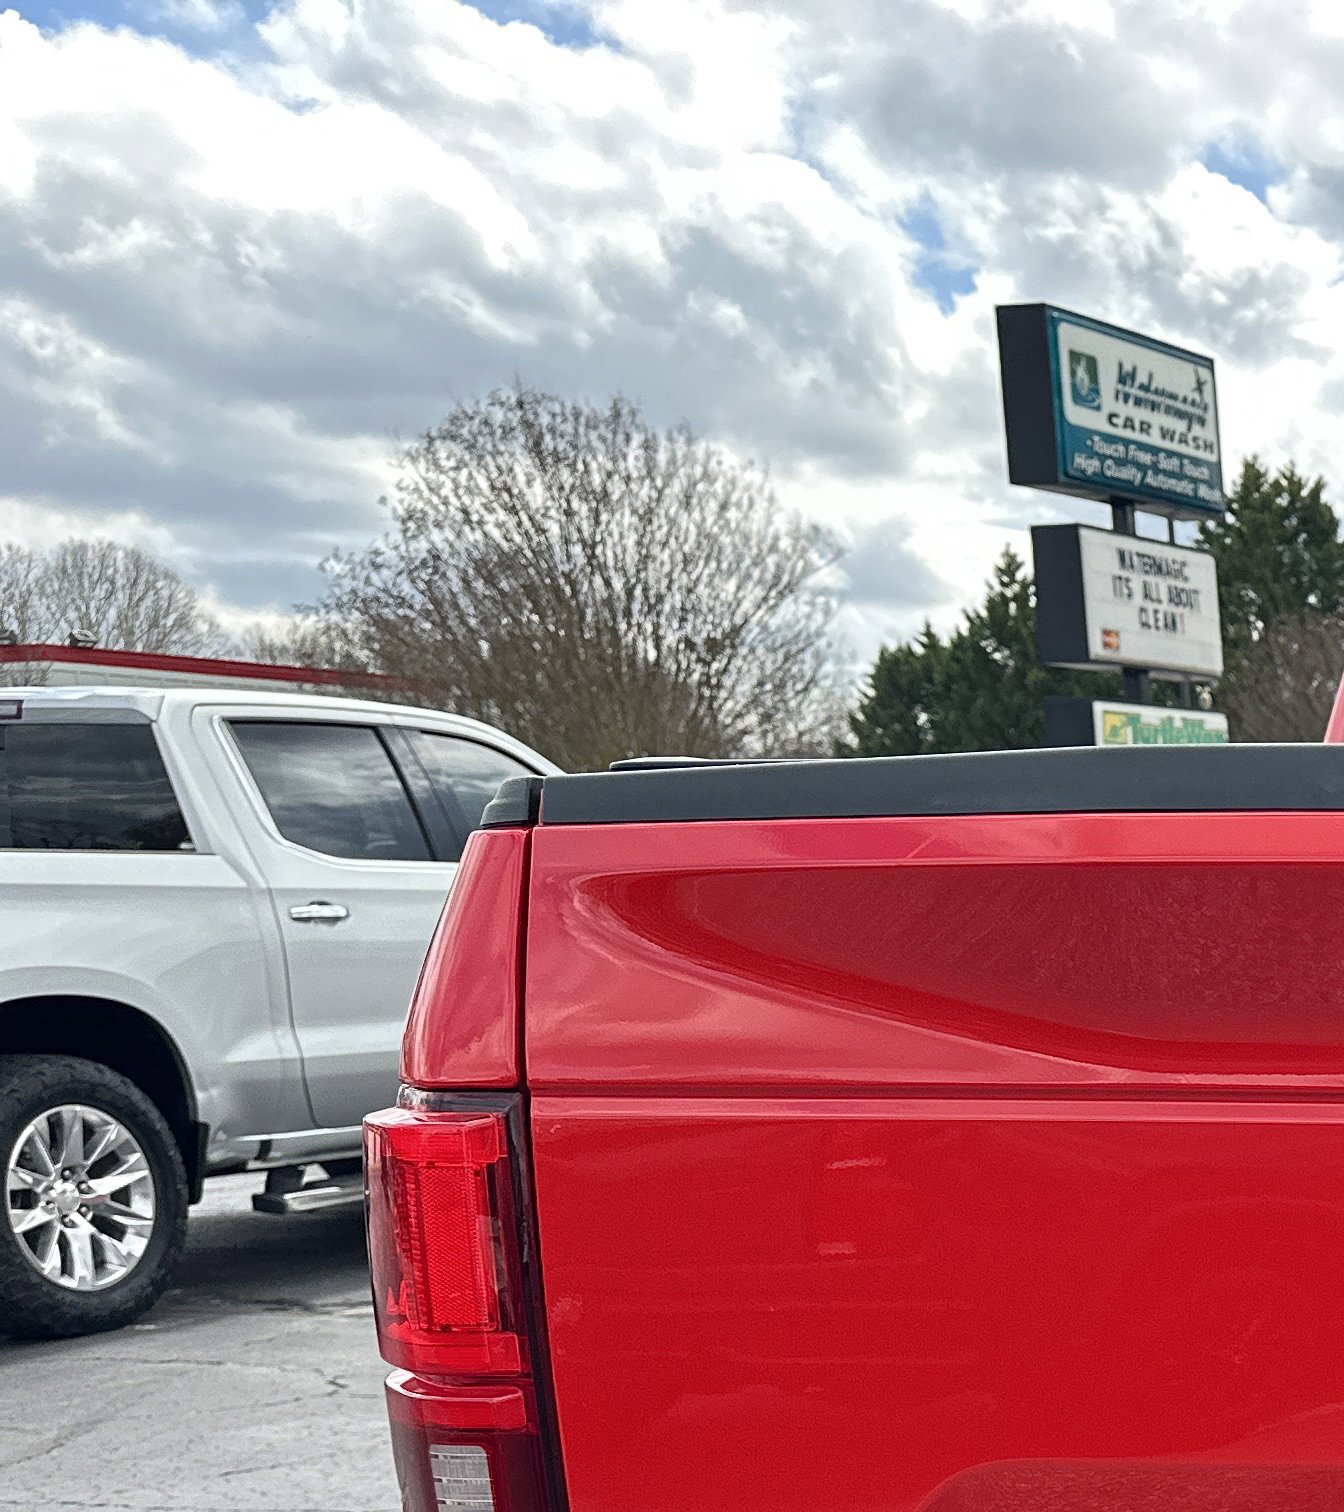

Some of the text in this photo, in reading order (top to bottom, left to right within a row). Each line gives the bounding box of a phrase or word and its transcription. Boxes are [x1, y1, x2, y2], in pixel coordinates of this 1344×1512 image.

[1107, 412, 1214, 454] CAR WASH
[1142, 579, 1163, 604] ALL
[1167, 585, 1201, 610] ABOUT
